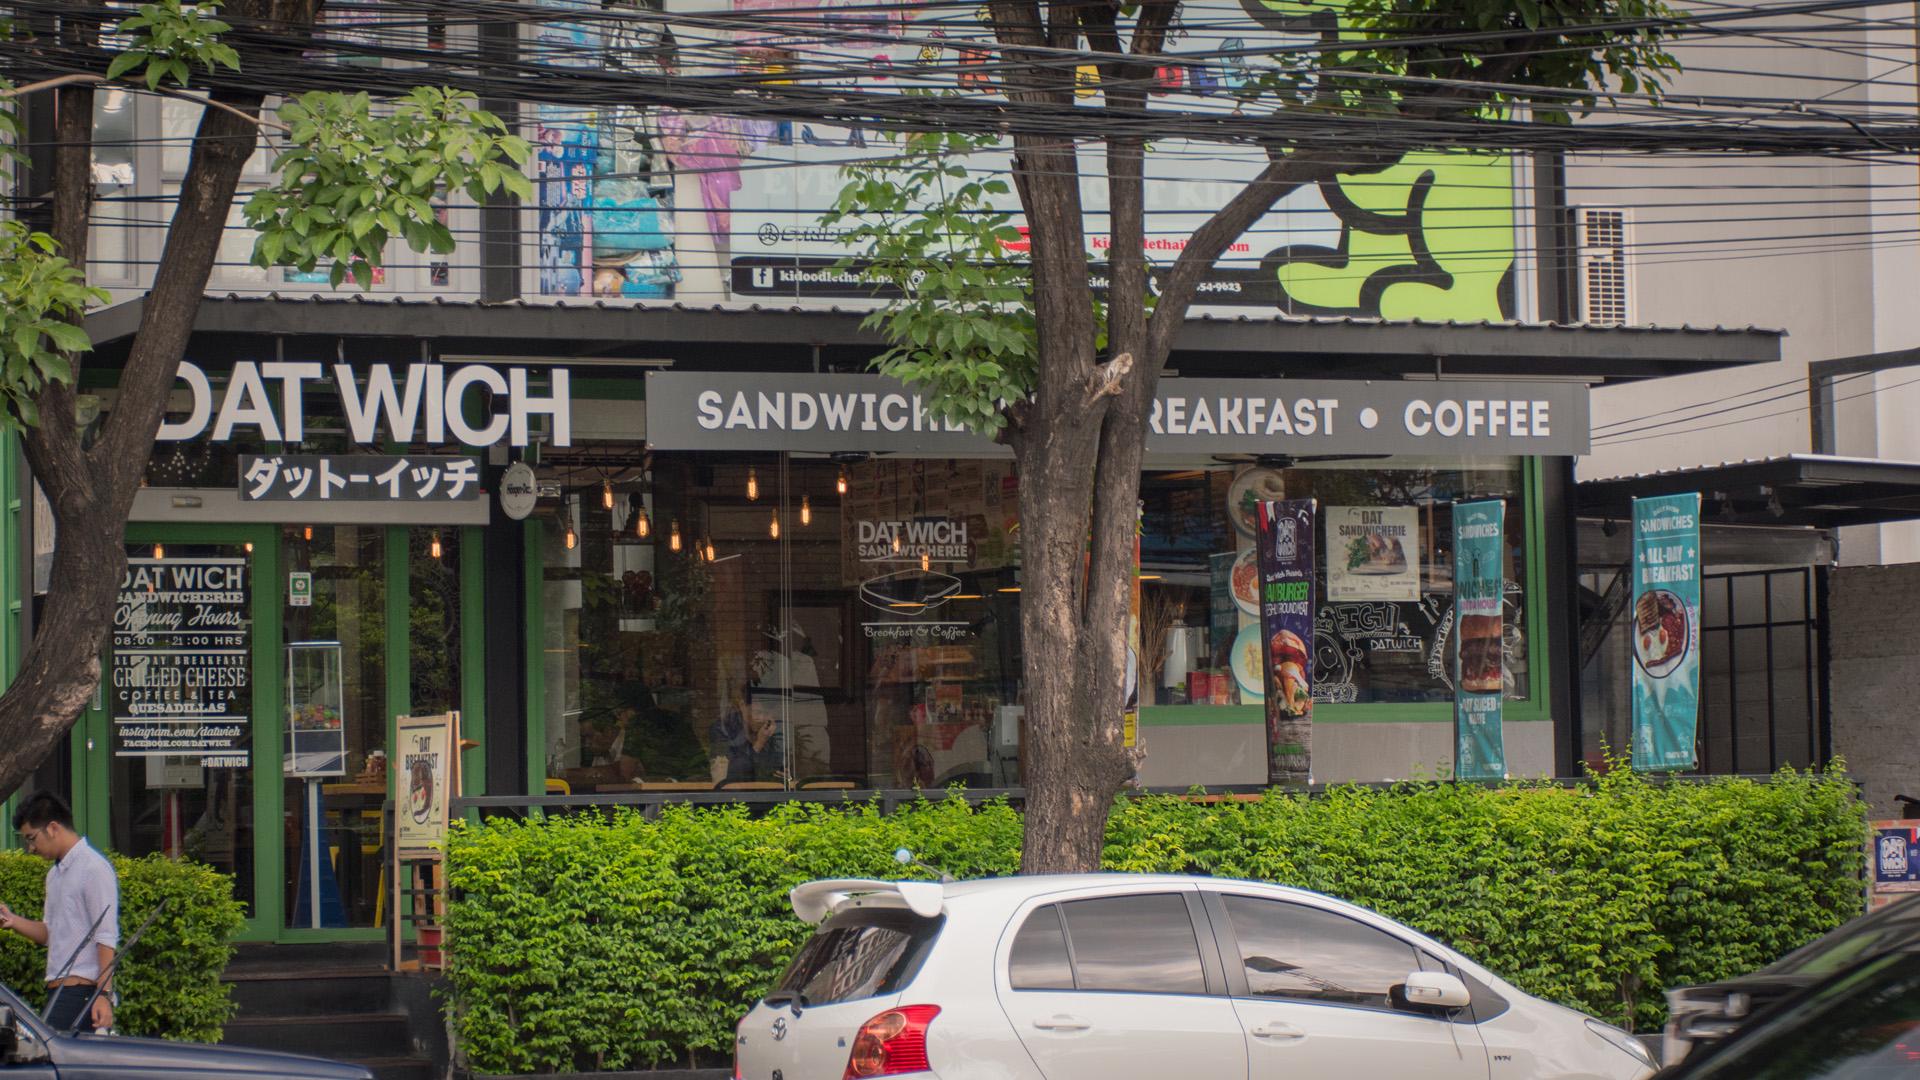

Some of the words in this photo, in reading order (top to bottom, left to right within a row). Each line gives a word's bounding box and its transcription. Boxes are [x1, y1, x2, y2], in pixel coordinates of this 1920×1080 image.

[333, 363, 571, 447] WICH
[1149, 397, 1339, 436] REAKFAST
[1404, 399, 1551, 437] COFFEE
[244, 458, 480, 499] ダットーイッチ
[1362, 510, 1383, 524] DAT
[859, 521, 902, 543] DAT
[906, 521, 967, 544] WICH
[1339, 525, 1407, 537] SANDWICHERIE
[859, 544, 968, 557] SANDWICHERIE
[172, 567, 243, 589] WICH
[188, 604, 242, 626] Hours
[864, 625, 912, 639] Breakfast
[931, 625, 966, 640] Coffee
[215, 637, 243, 645] HRS
[1370, 639, 1422, 650] DATWICH
[175, 656, 244, 665] BREAKFAST
[185, 668, 246, 687] CHEESE
[120, 691, 180, 700] COFFEE
[190, 691, 198, 700] &
[209, 691, 236, 700] TEA
[128, 703, 226, 714] QUESADILLAS
[119, 726, 240, 739] instagram.com/datwich
[420, 736, 431, 752] DAT
[200, 757, 248, 768] #DATWICH
